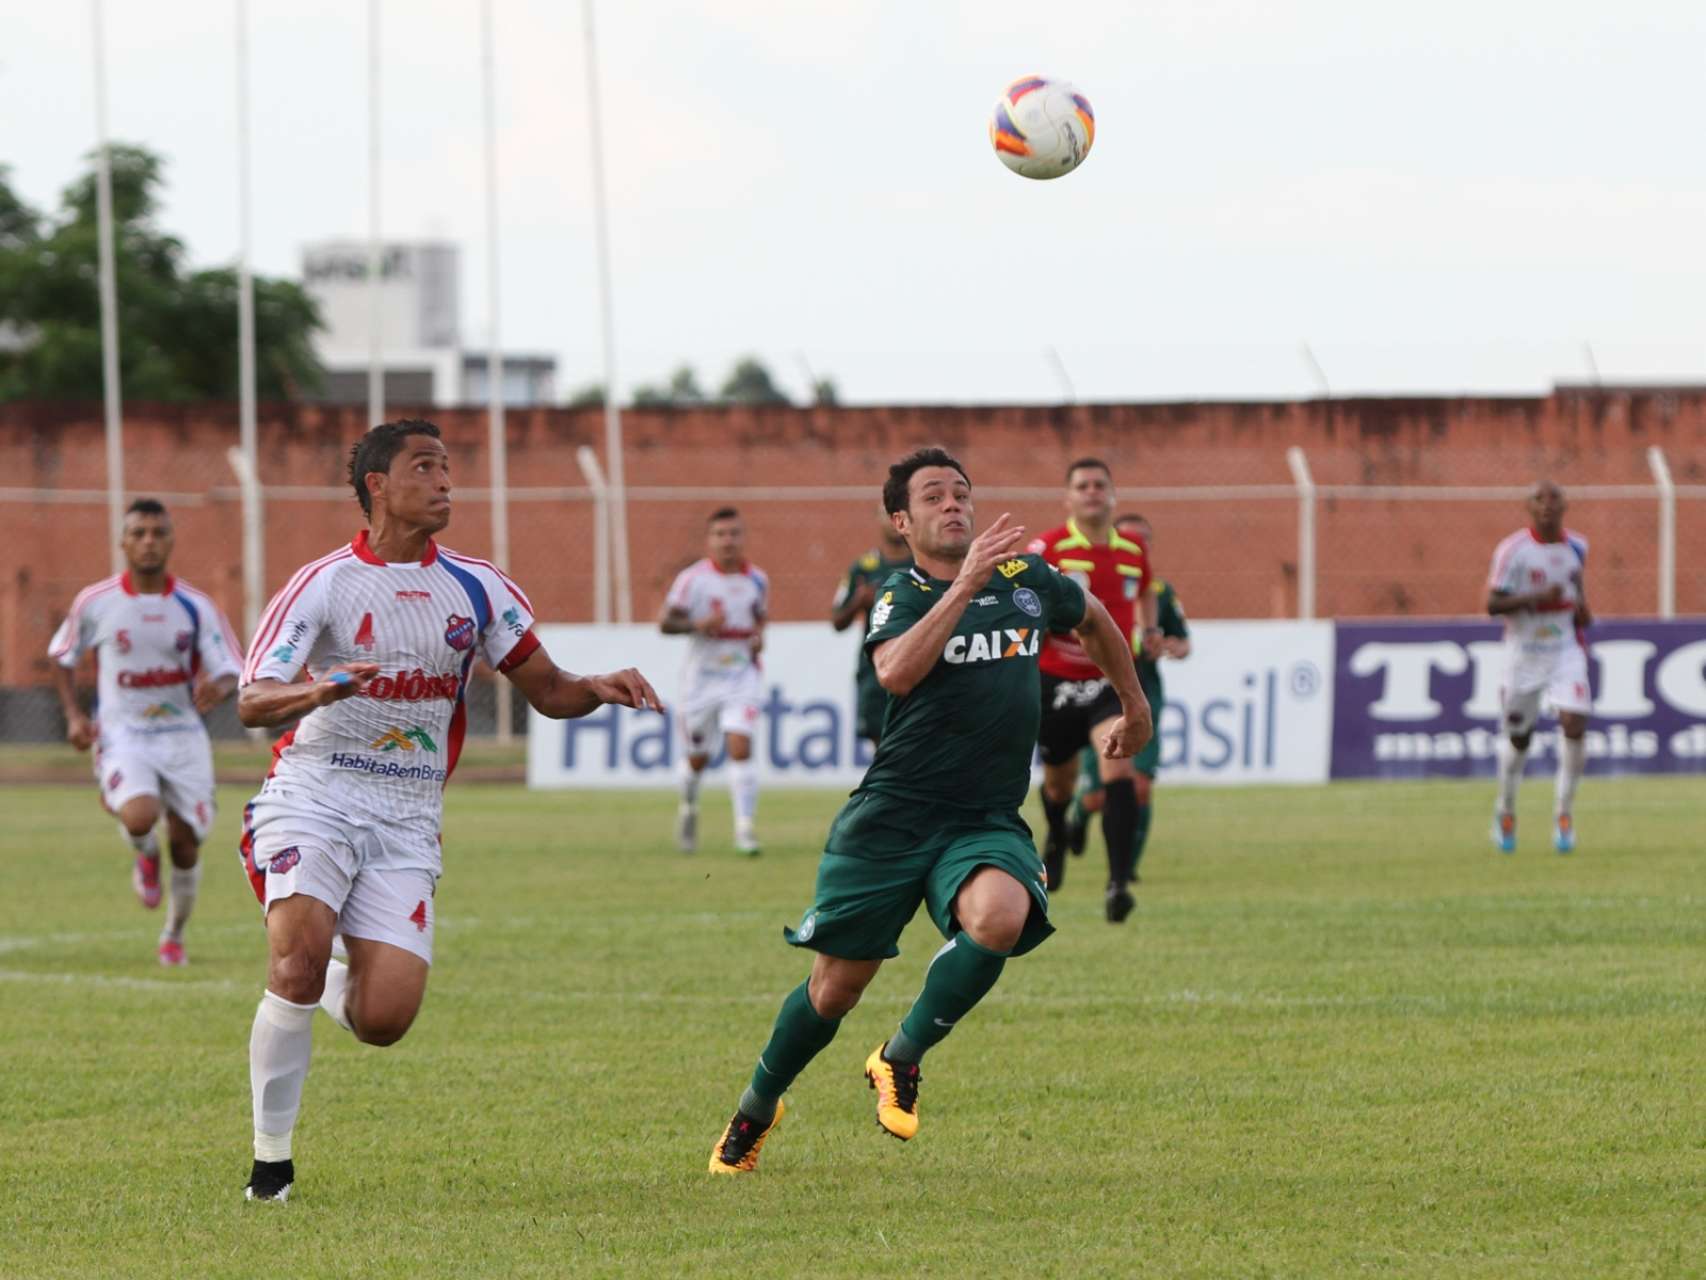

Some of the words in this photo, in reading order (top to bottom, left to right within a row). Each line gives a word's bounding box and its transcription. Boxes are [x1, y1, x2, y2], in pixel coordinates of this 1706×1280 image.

[116, 629, 132, 654] 5
[353, 612, 374, 652] 4
[409, 899, 427, 933] 4
